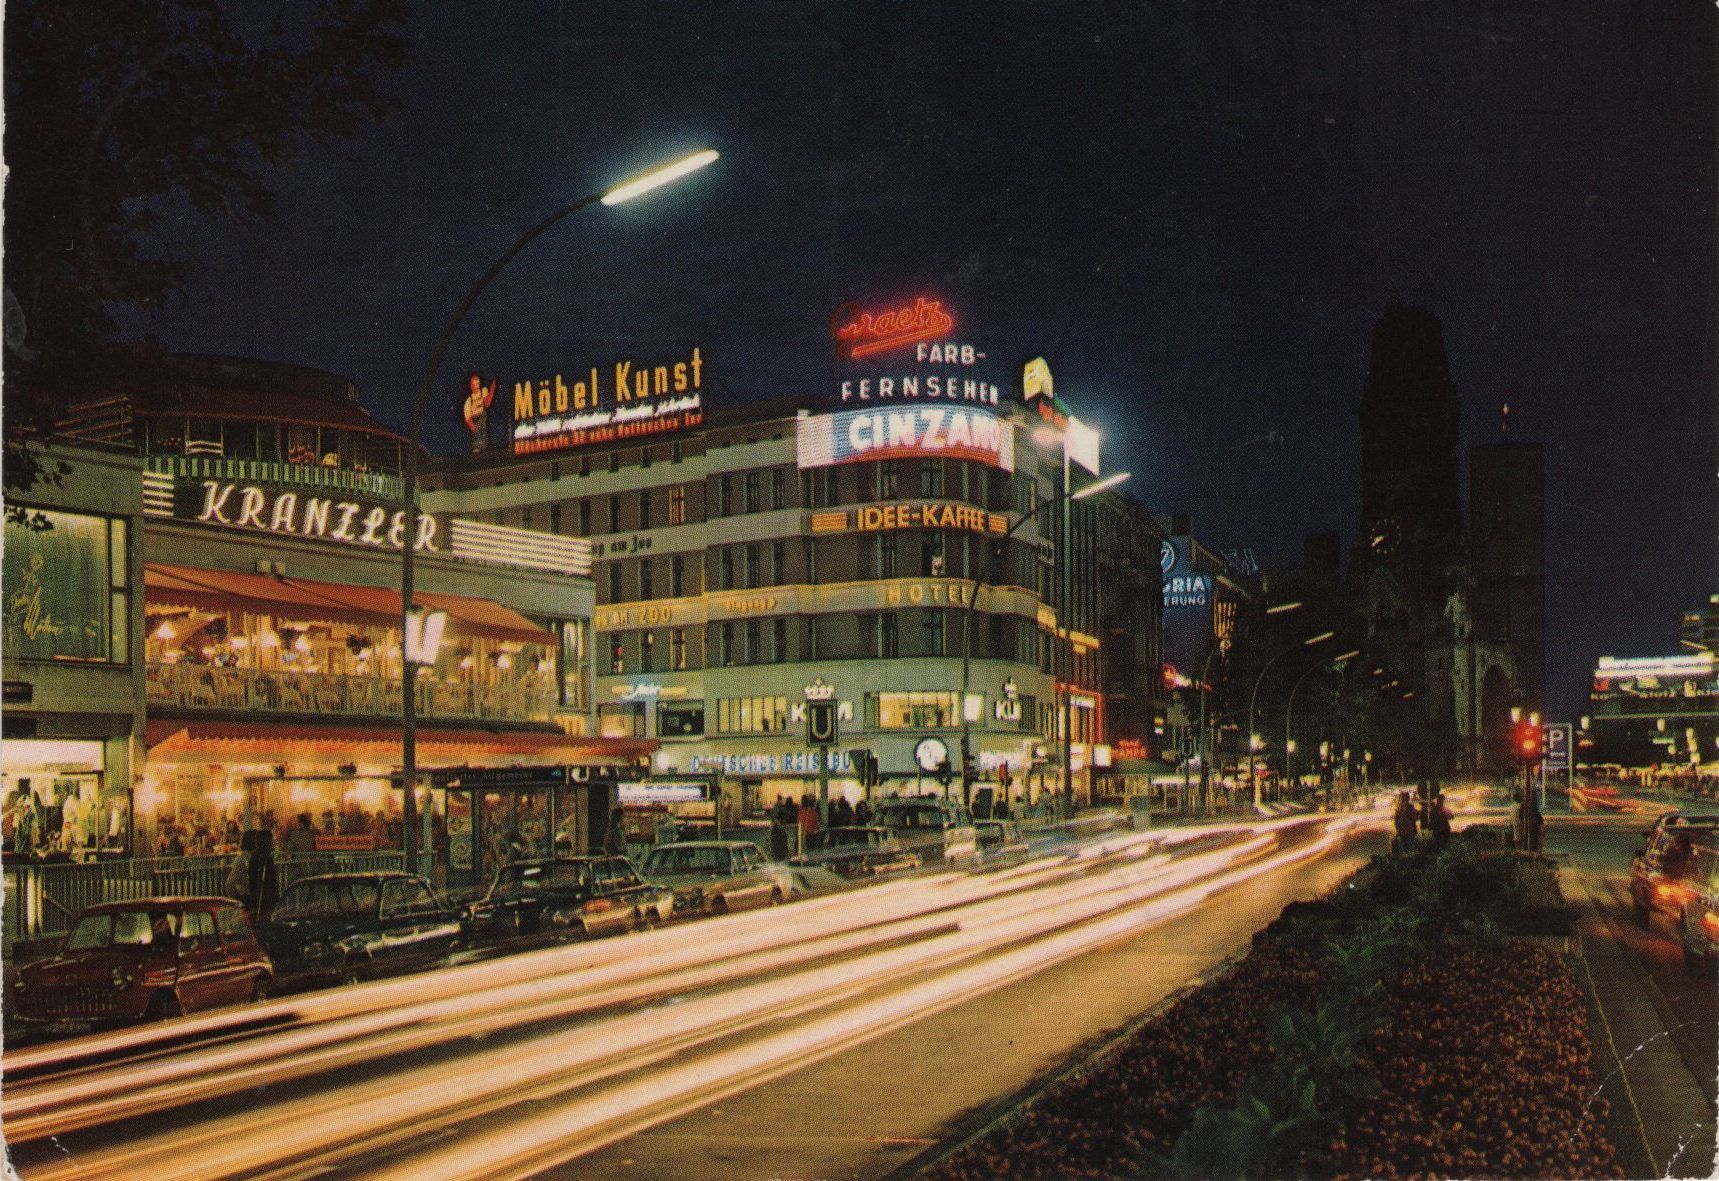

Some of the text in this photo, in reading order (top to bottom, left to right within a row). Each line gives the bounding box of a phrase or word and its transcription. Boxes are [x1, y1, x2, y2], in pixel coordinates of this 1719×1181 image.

[916, 343, 986, 366] FARB-
[514, 367, 598, 421] Möbel
[615, 347, 703, 402] Kunst
[841, 376, 998, 405] FERNSEHEN
[198, 481, 438, 552] KRANZLER
[857, 504, 985, 531] IDEE-KAFFEE
[888, 583, 969, 605] HOTEL
[811, 707, 832, 739] U
